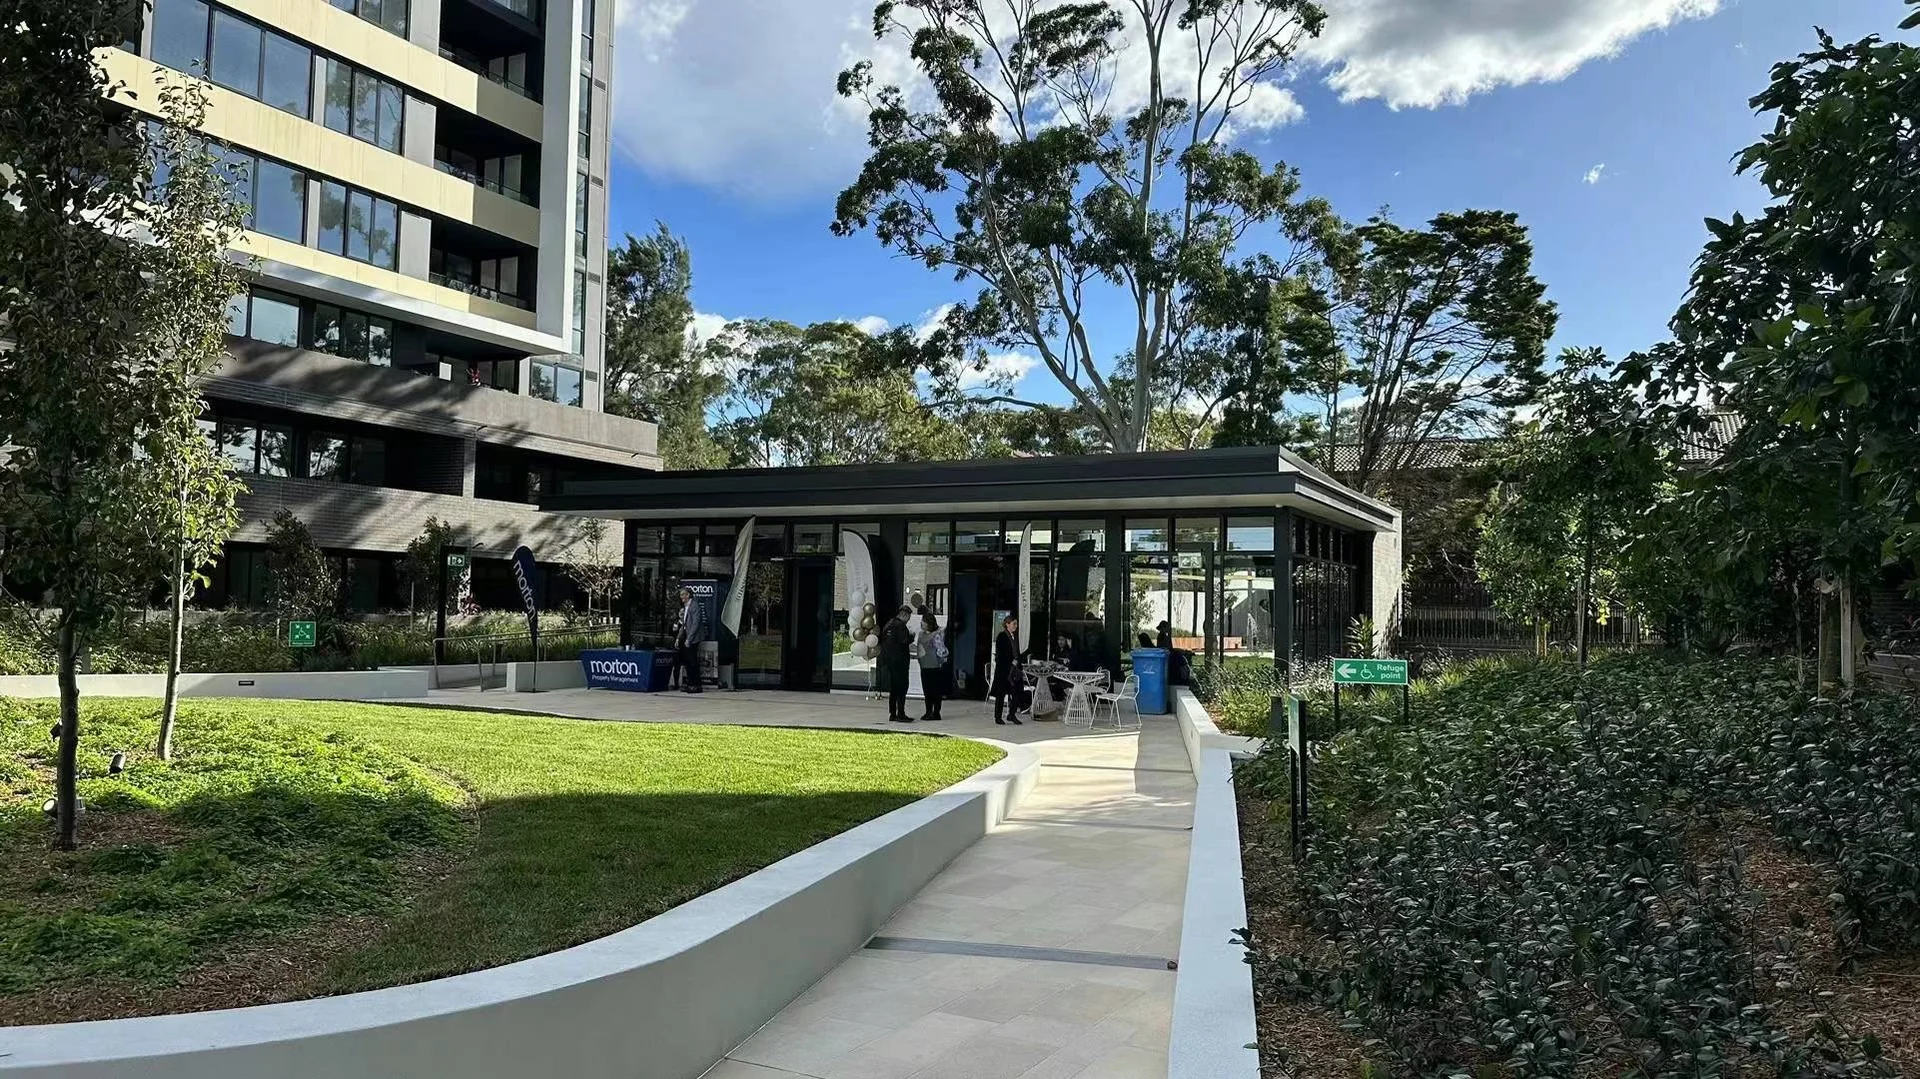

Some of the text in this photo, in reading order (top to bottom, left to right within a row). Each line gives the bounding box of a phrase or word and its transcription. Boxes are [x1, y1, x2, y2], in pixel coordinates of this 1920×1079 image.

[513, 560, 536, 621] morton
[1377, 664, 1404, 673] Refuge
[610, 675, 638, 683] Management
[1381, 671, 1401, 680] point
